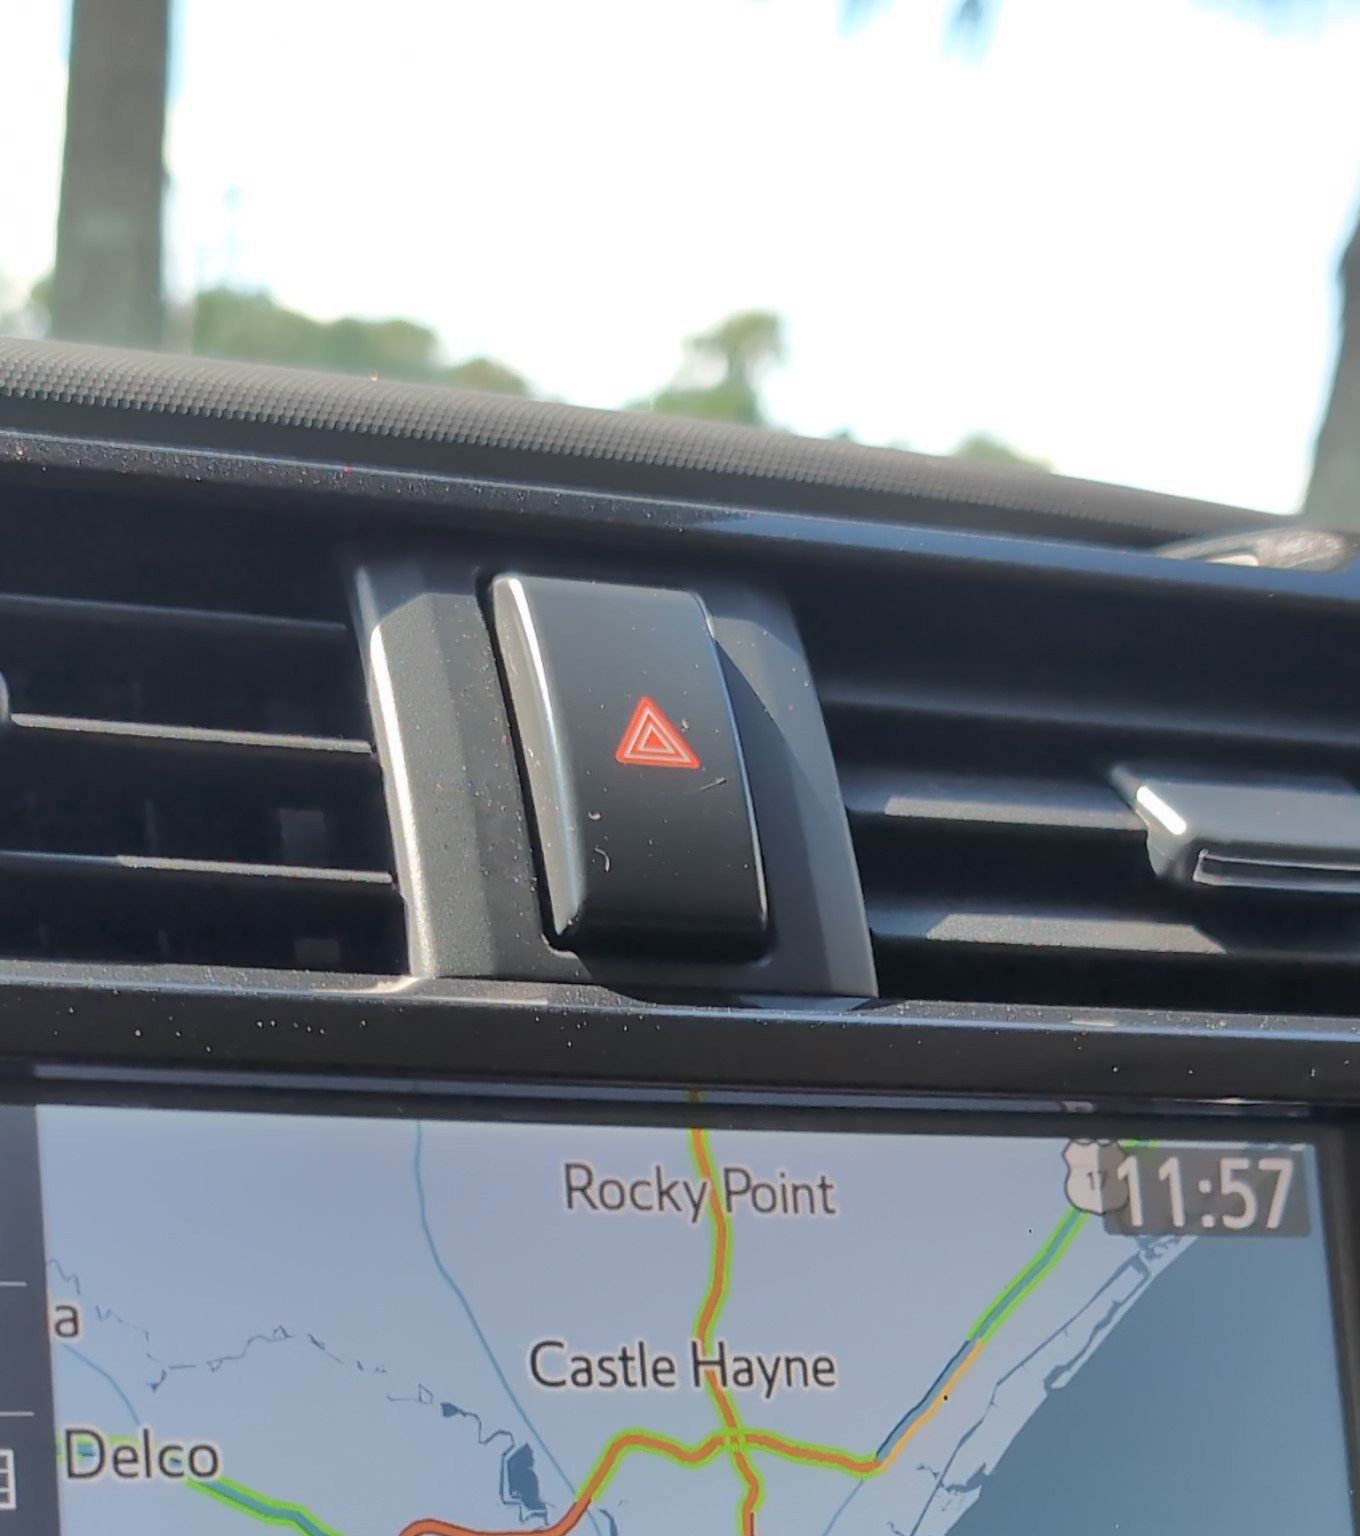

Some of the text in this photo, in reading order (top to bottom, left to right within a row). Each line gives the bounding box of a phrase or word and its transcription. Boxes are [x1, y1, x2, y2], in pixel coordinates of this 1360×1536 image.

[563, 1162, 837, 1223] Rocky Point
[1116, 1155, 1295, 1230] 11:57
[529, 1341, 837, 1403] Castle Hayne
[64, 1427, 220, 1480] Delco
